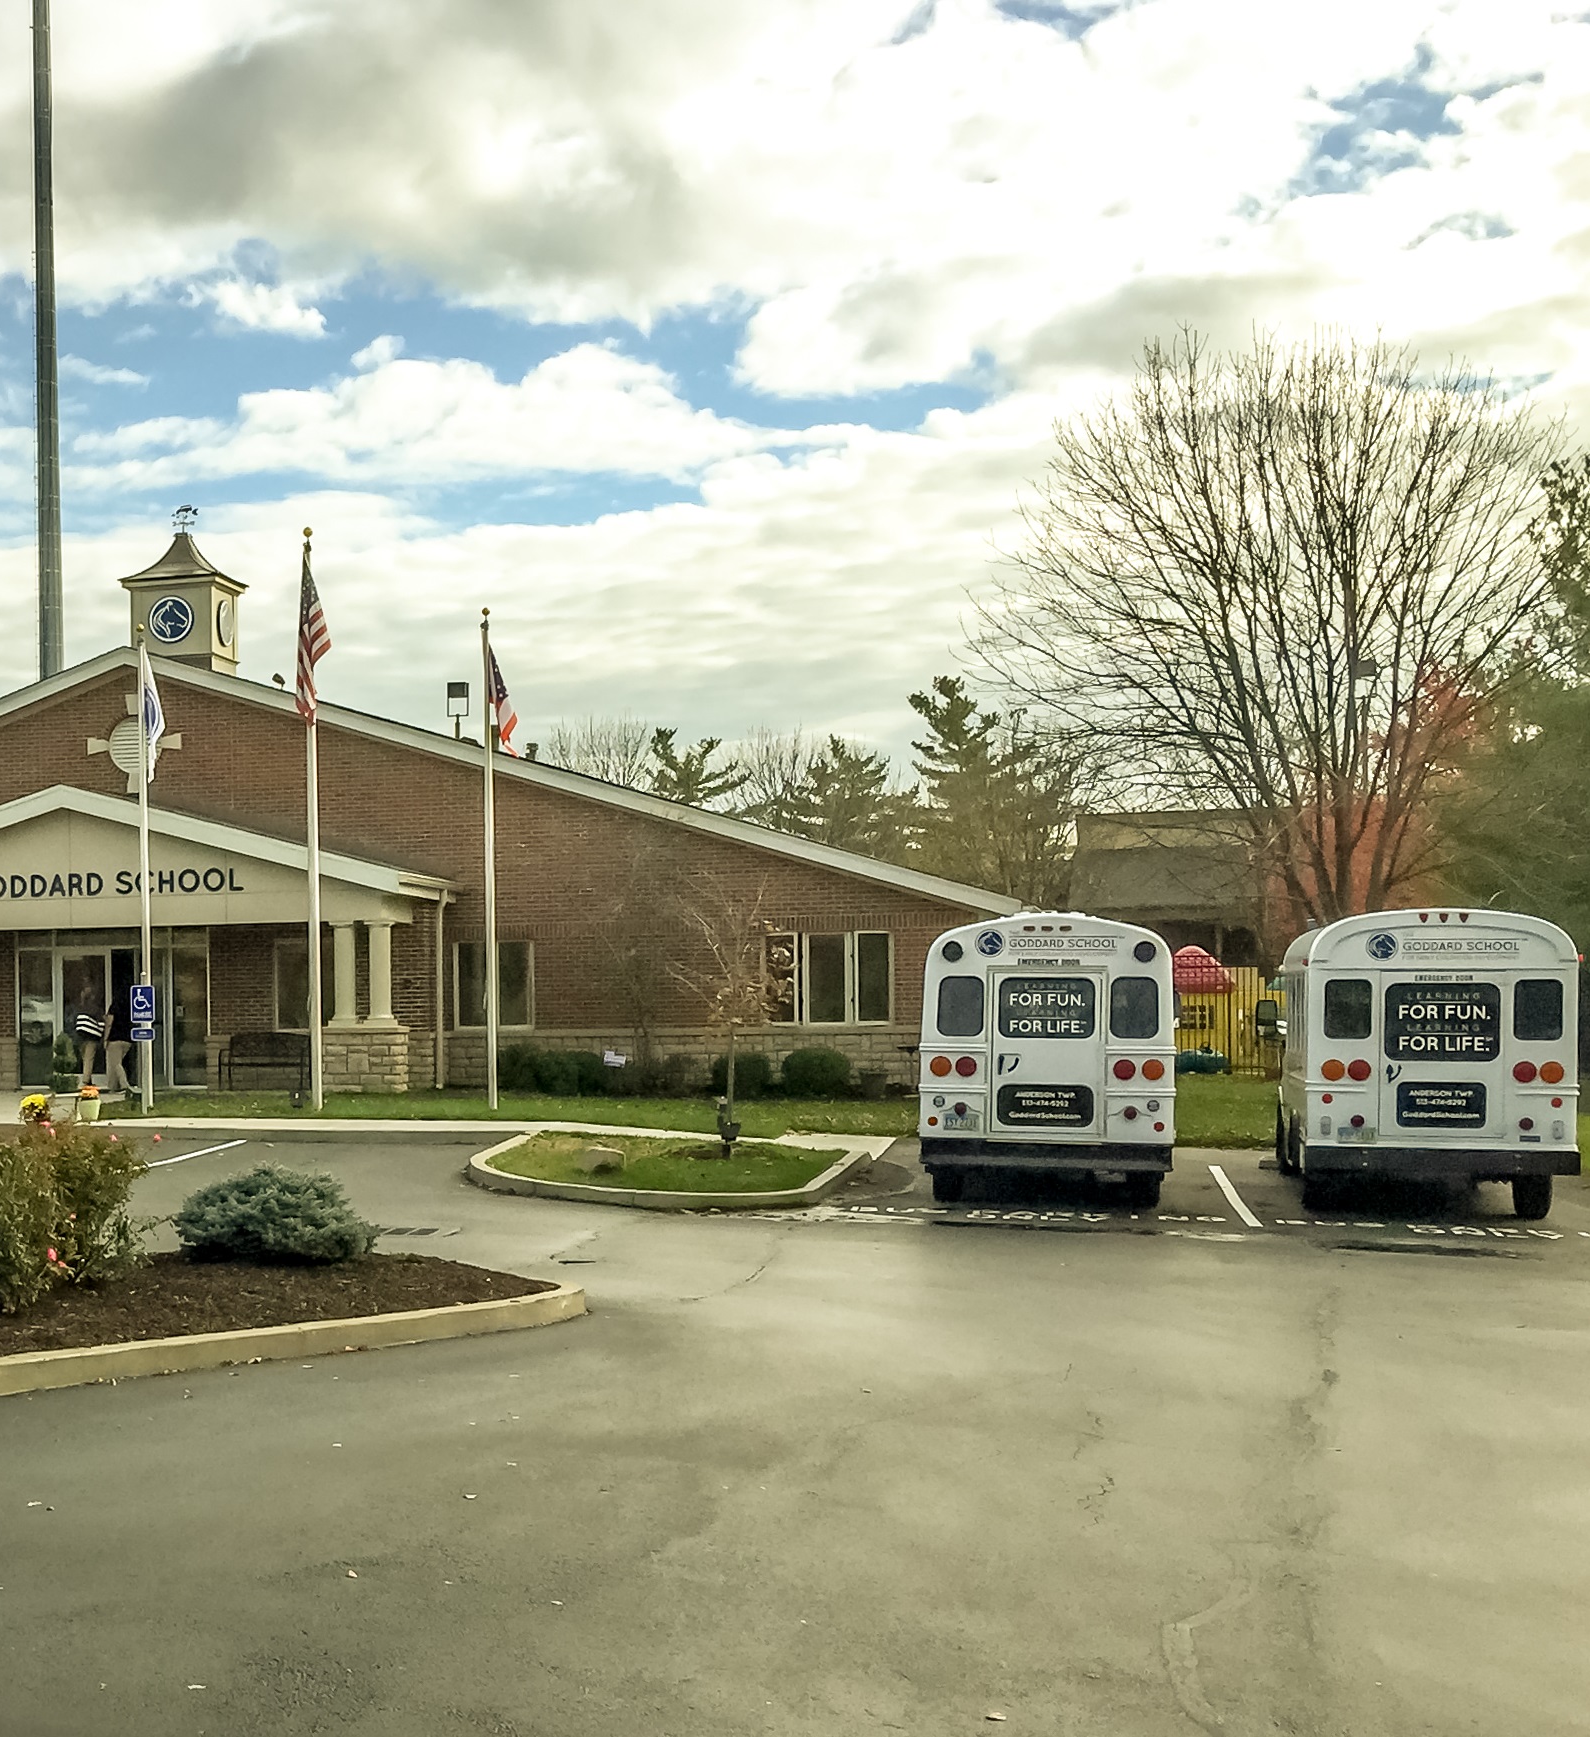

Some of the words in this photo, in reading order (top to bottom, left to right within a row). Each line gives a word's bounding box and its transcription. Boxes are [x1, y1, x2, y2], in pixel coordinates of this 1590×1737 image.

[115, 868, 244, 896] SCHOOL
[1009, 938, 1065, 948] GODDARD
[1067, 938, 1117, 949] SCHOOL
[1402, 941, 1463, 951] GODDARD
[1466, 941, 1520, 951] SCHOOL
[1009, 993, 1042, 1006] FOR
[1047, 993, 1086, 1007] FUN.
[1398, 1004, 1438, 1020] FOR
[1444, 1004, 1491, 1020] FUN.
[1009, 1020, 1042, 1033] FOR
[1047, 1020, 1085, 1034] LIFE.
[1398, 1036, 1438, 1051] FOR
[1444, 1036, 1490, 1052] LIFE.
